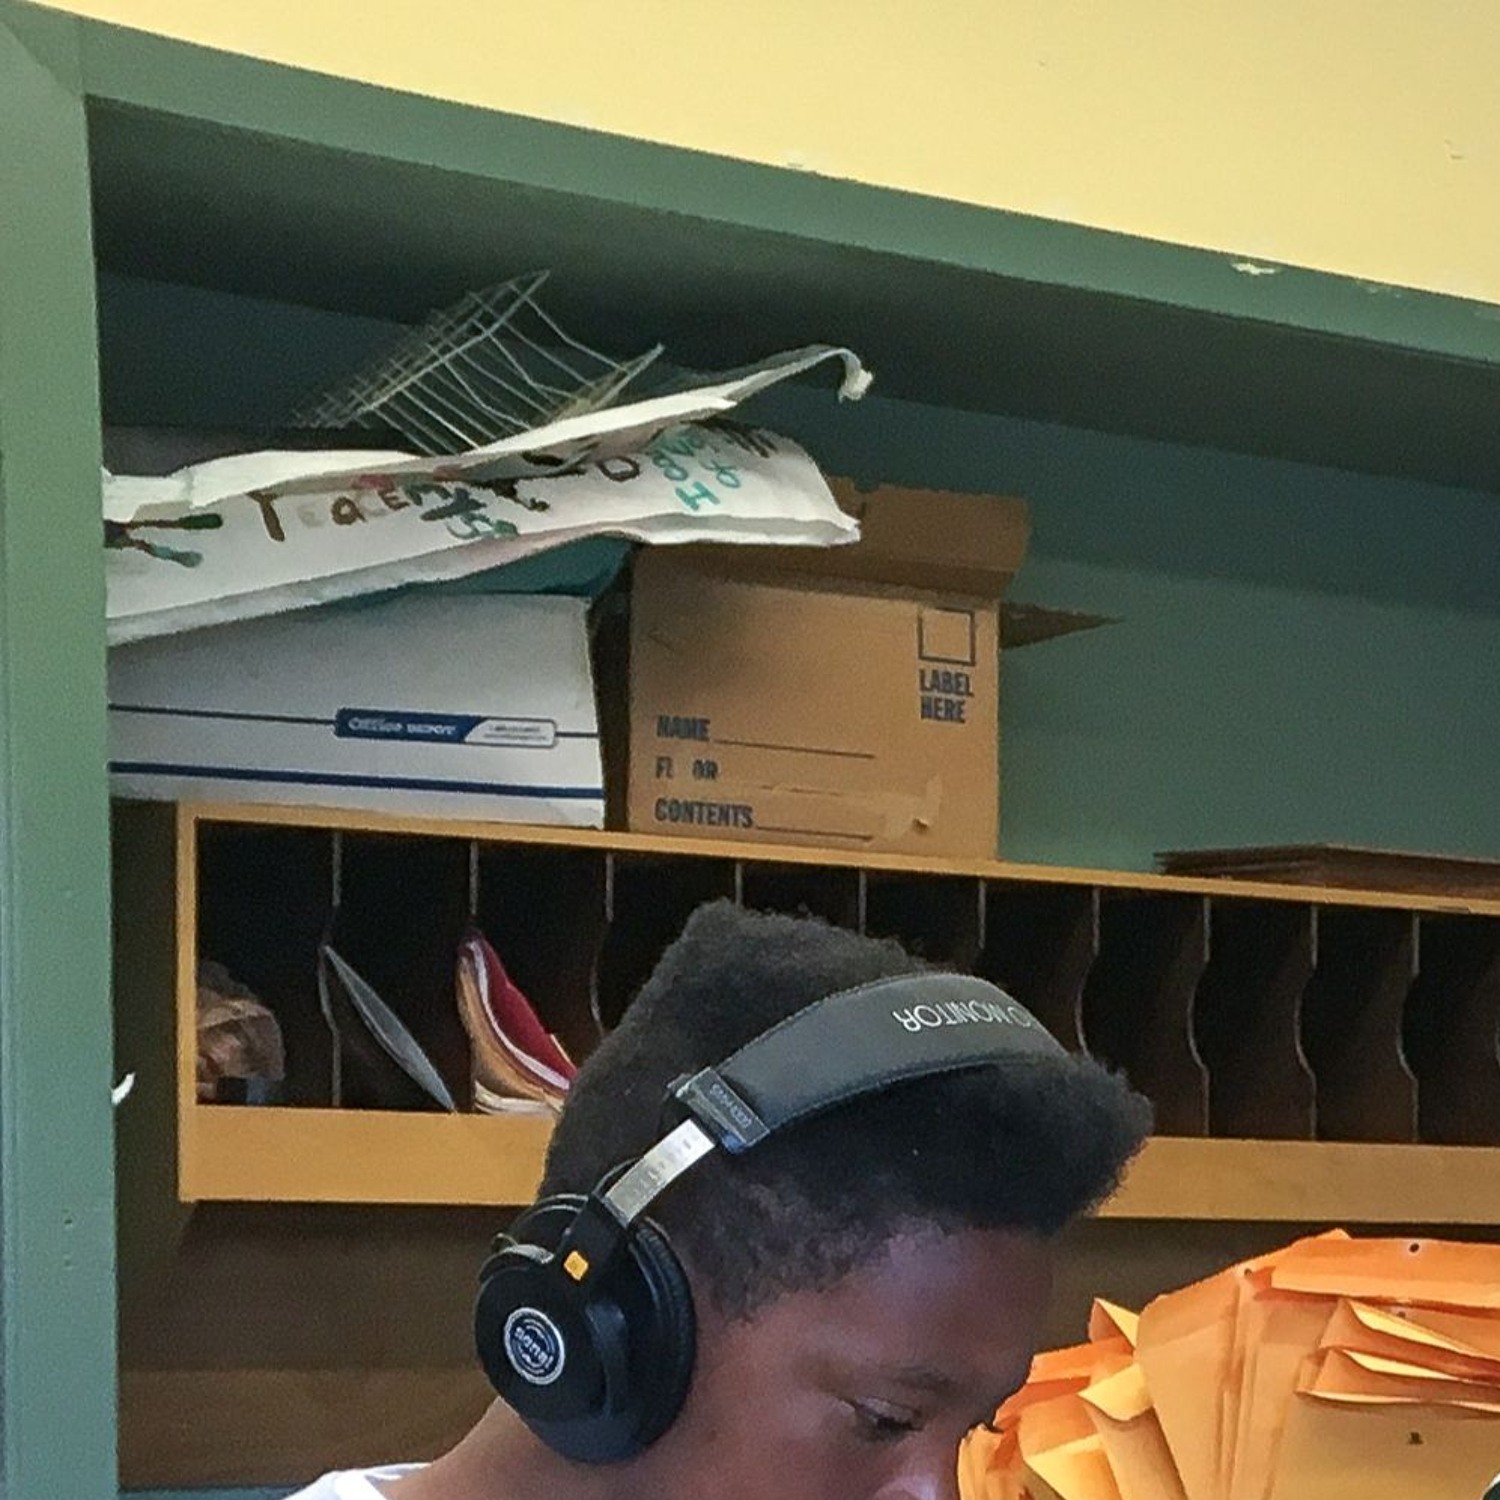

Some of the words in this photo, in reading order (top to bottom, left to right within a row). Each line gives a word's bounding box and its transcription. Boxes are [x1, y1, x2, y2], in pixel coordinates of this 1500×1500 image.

[919, 669, 974, 698] LABEL
[920, 696, 966, 724] HERE
[656, 715, 711, 742] NAME
[655, 756, 718, 780] FLOR
[655, 797, 753, 829] CONTENTS
[892, 999, 1013, 1032] MONITOR
